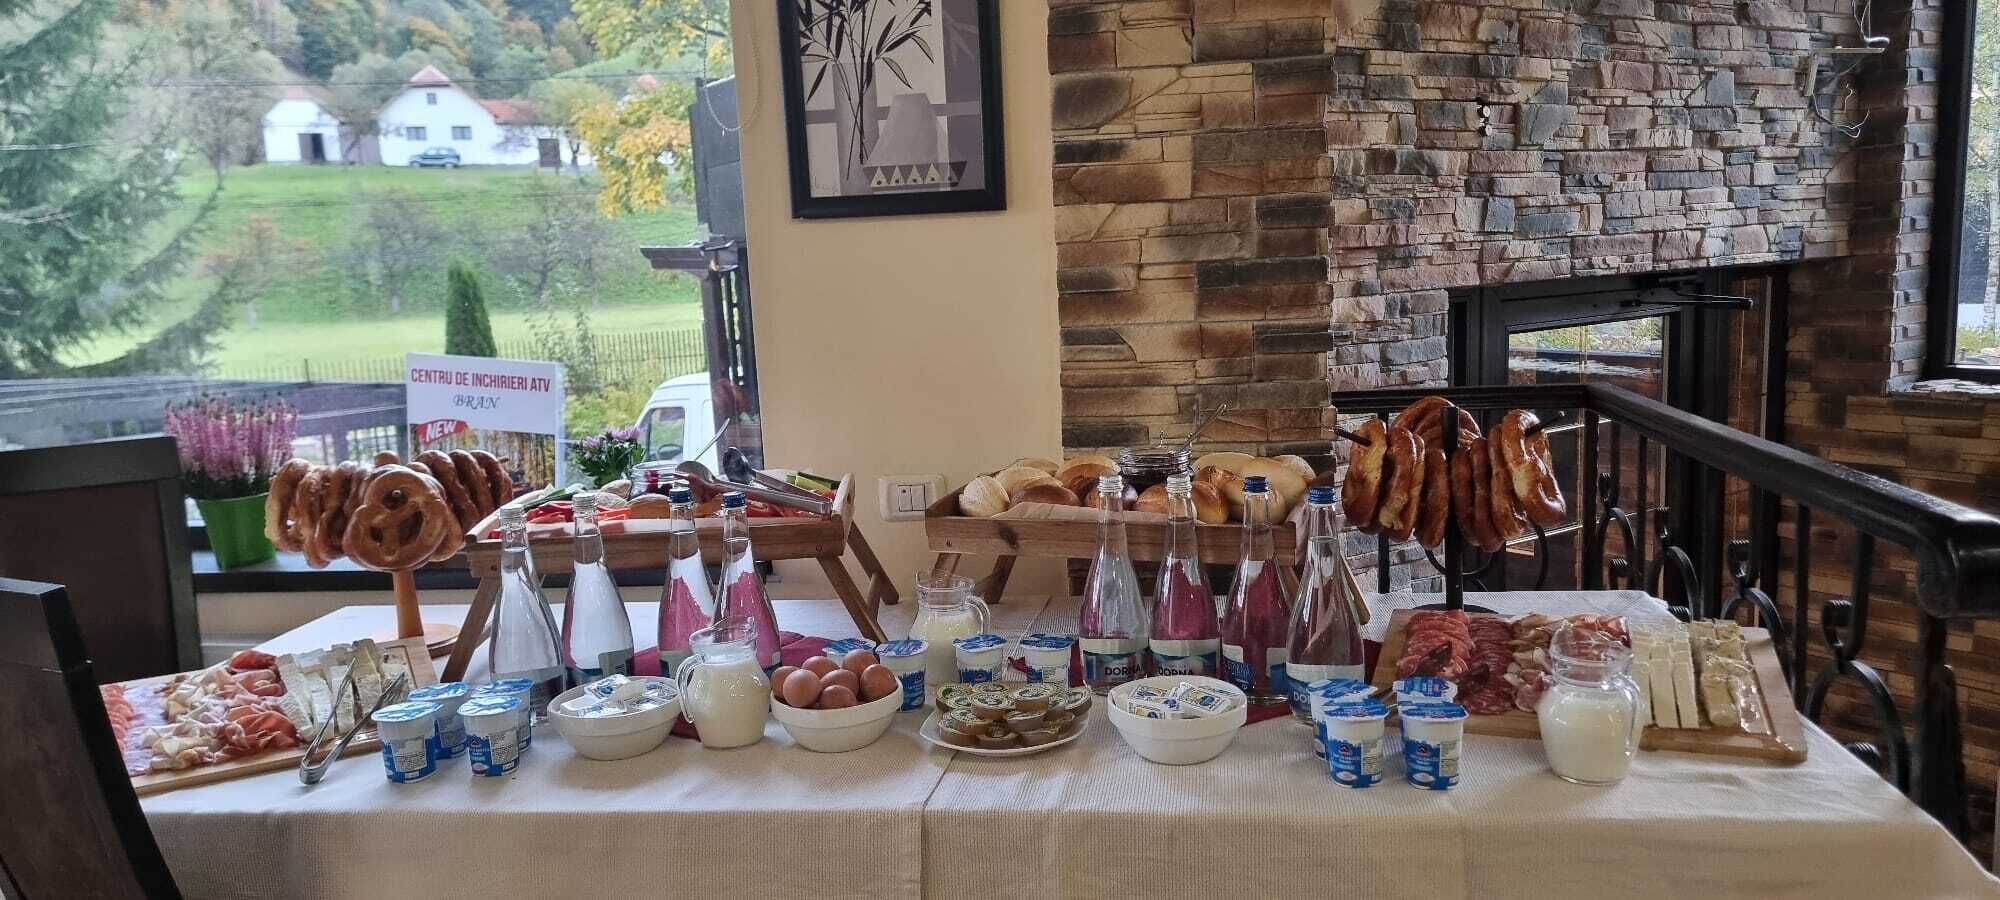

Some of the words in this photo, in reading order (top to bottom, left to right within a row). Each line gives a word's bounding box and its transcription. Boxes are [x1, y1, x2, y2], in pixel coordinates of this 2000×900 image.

[411, 368, 452, 385] CENTRU
[455, 371, 469, 386] DE
[472, 373, 528, 391] INCHIRIERI
[530, 376, 550, 392] ATV
[454, 394, 500, 410] BRAN
[425, 421, 456, 442] NEW
